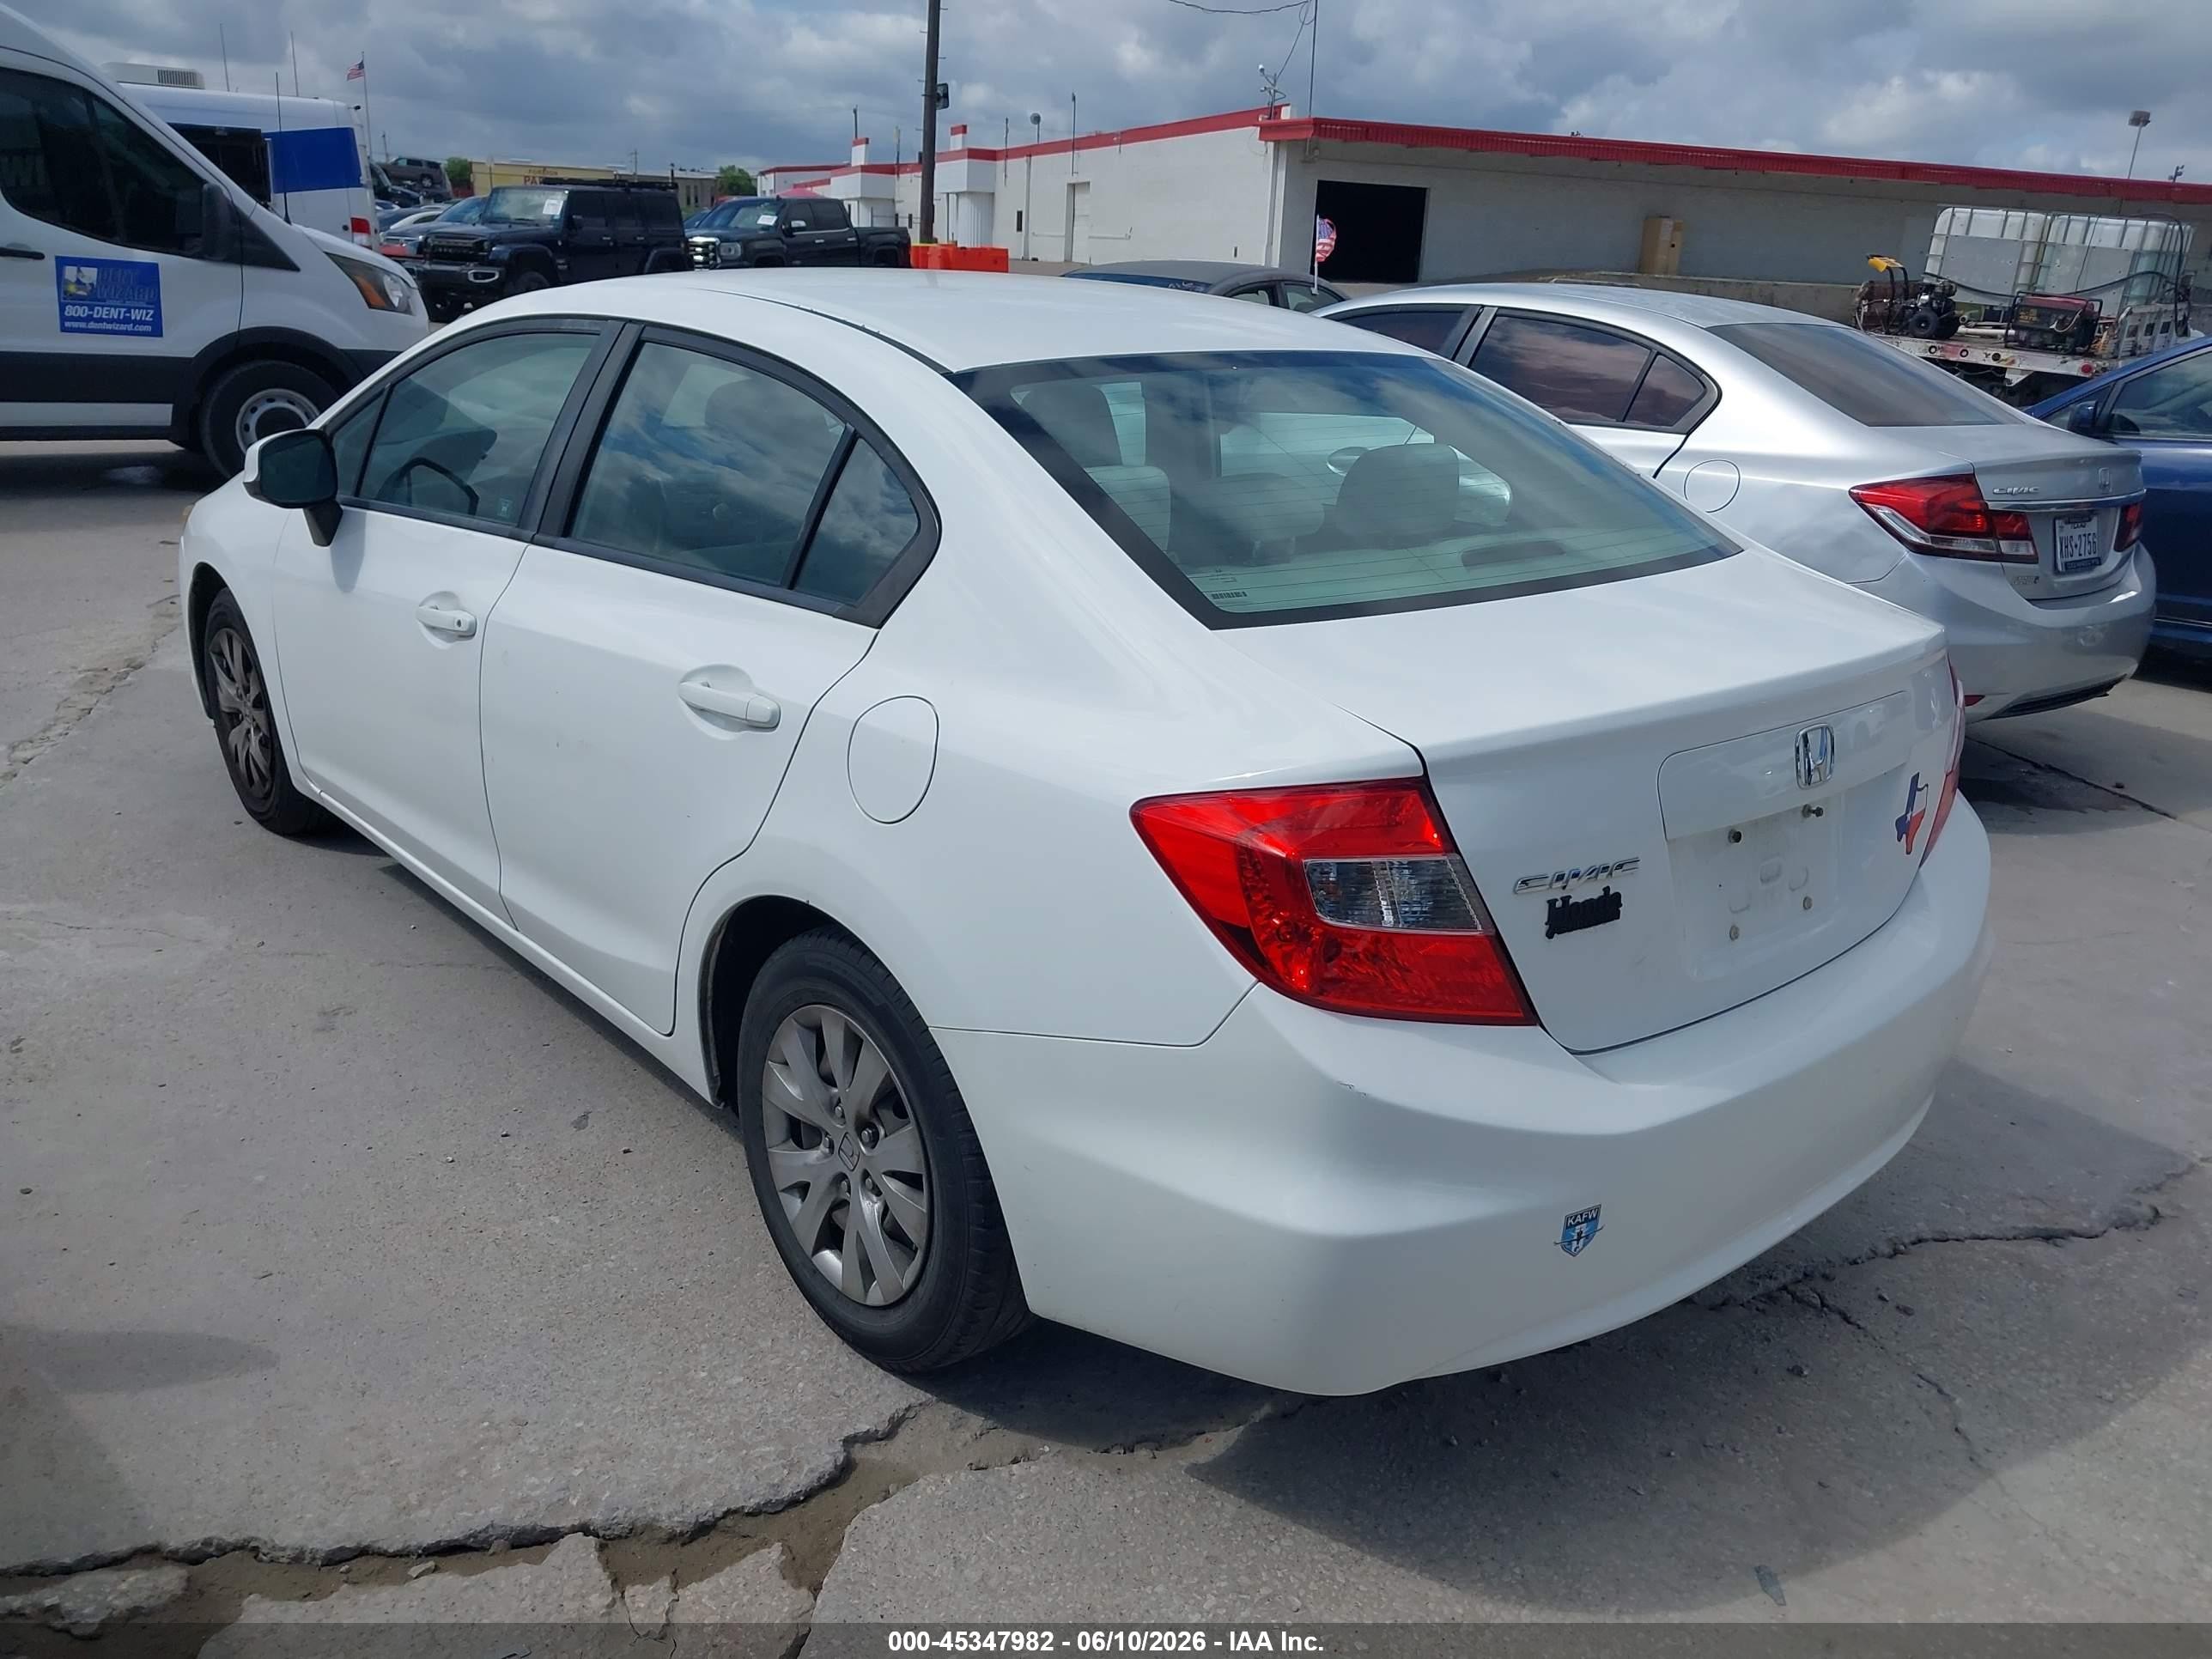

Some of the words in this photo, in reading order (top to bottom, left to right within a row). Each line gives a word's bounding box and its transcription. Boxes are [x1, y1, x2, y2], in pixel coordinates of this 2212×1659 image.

[64, 305, 154, 320] 800-DENT-WIZ
[64, 321, 151, 331] www.dentwizard.com
[1992, 486, 2040, 495] CIVIC
[1514, 858, 1640, 894] CIVIC
[1567, 1208, 1598, 1227] KAFW
